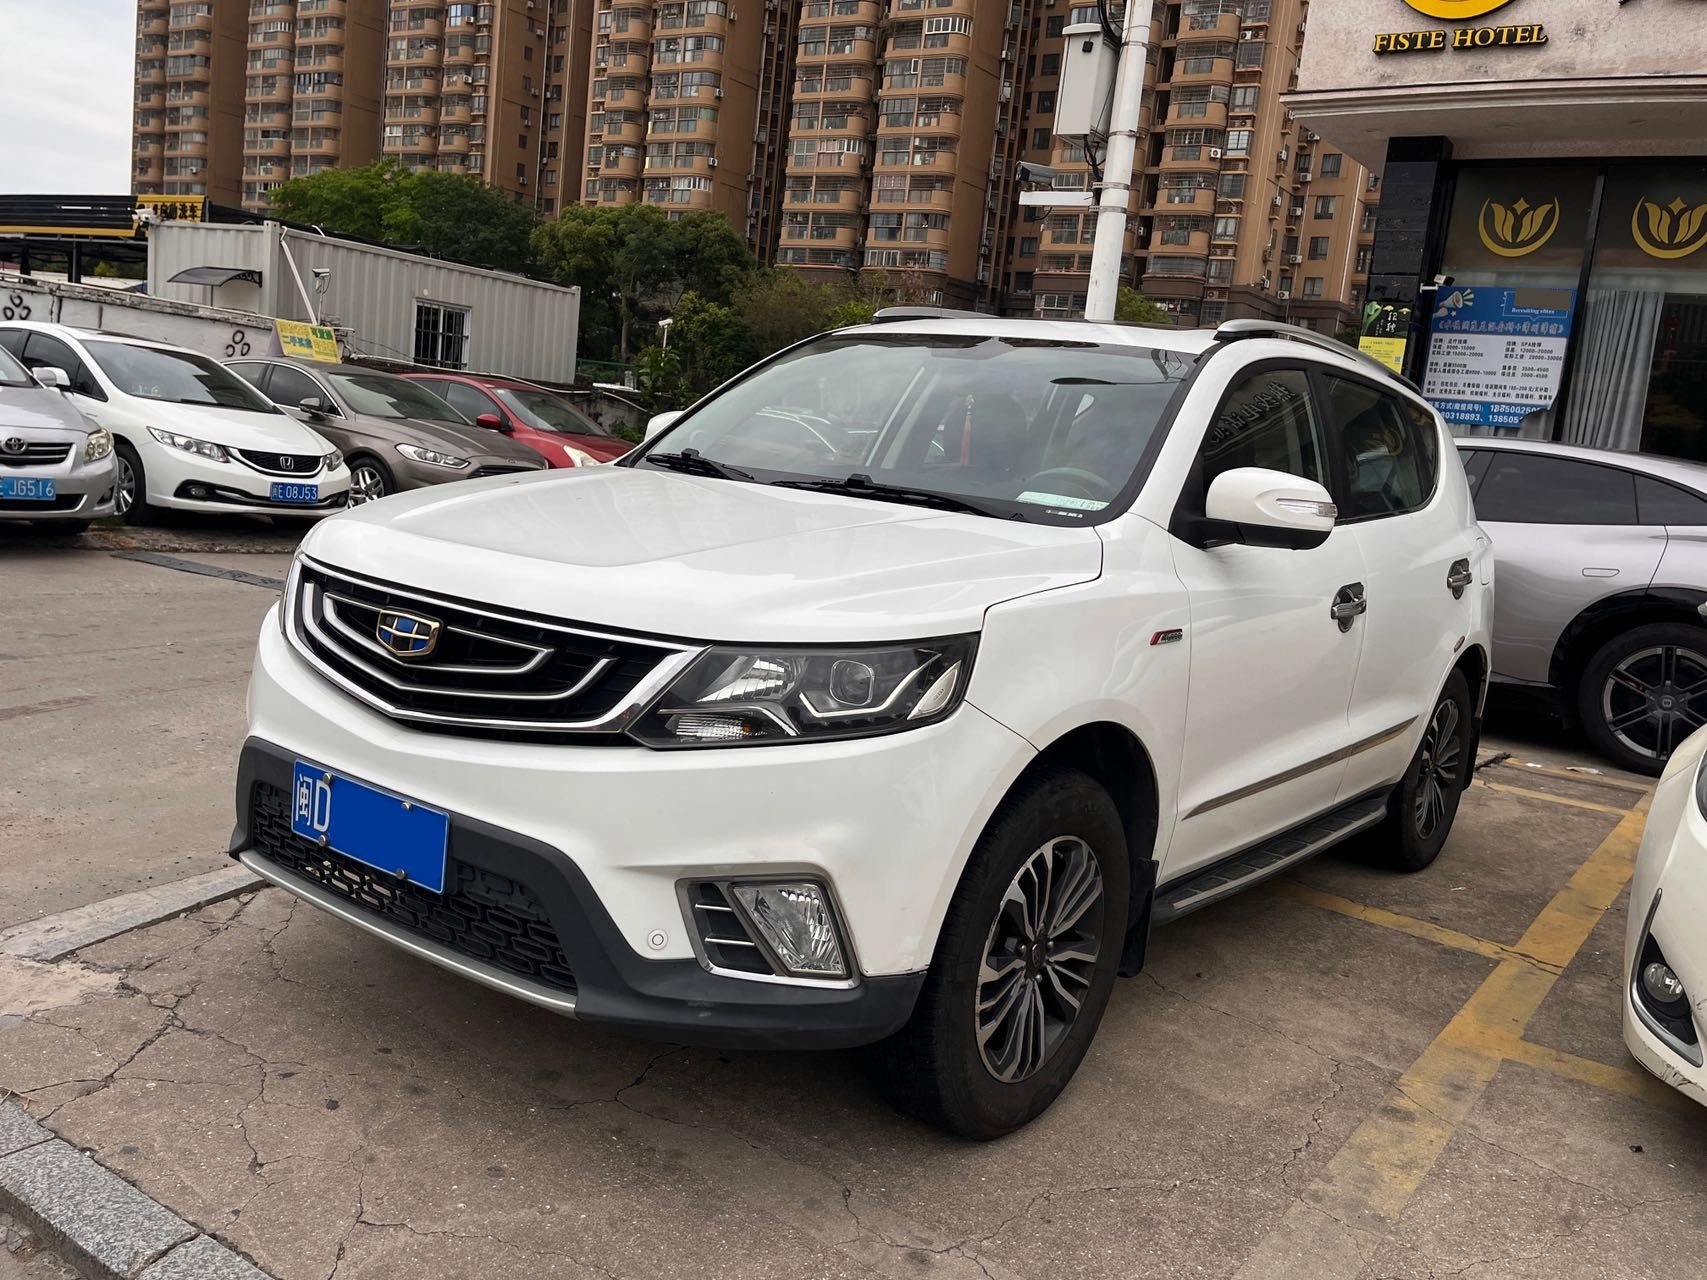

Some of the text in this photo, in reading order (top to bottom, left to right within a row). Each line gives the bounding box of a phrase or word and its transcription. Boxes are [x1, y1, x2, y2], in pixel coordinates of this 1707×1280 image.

[1374, 24, 1548, 53] FISTE HOTEL
[295, 773, 331, 833] 闽D
